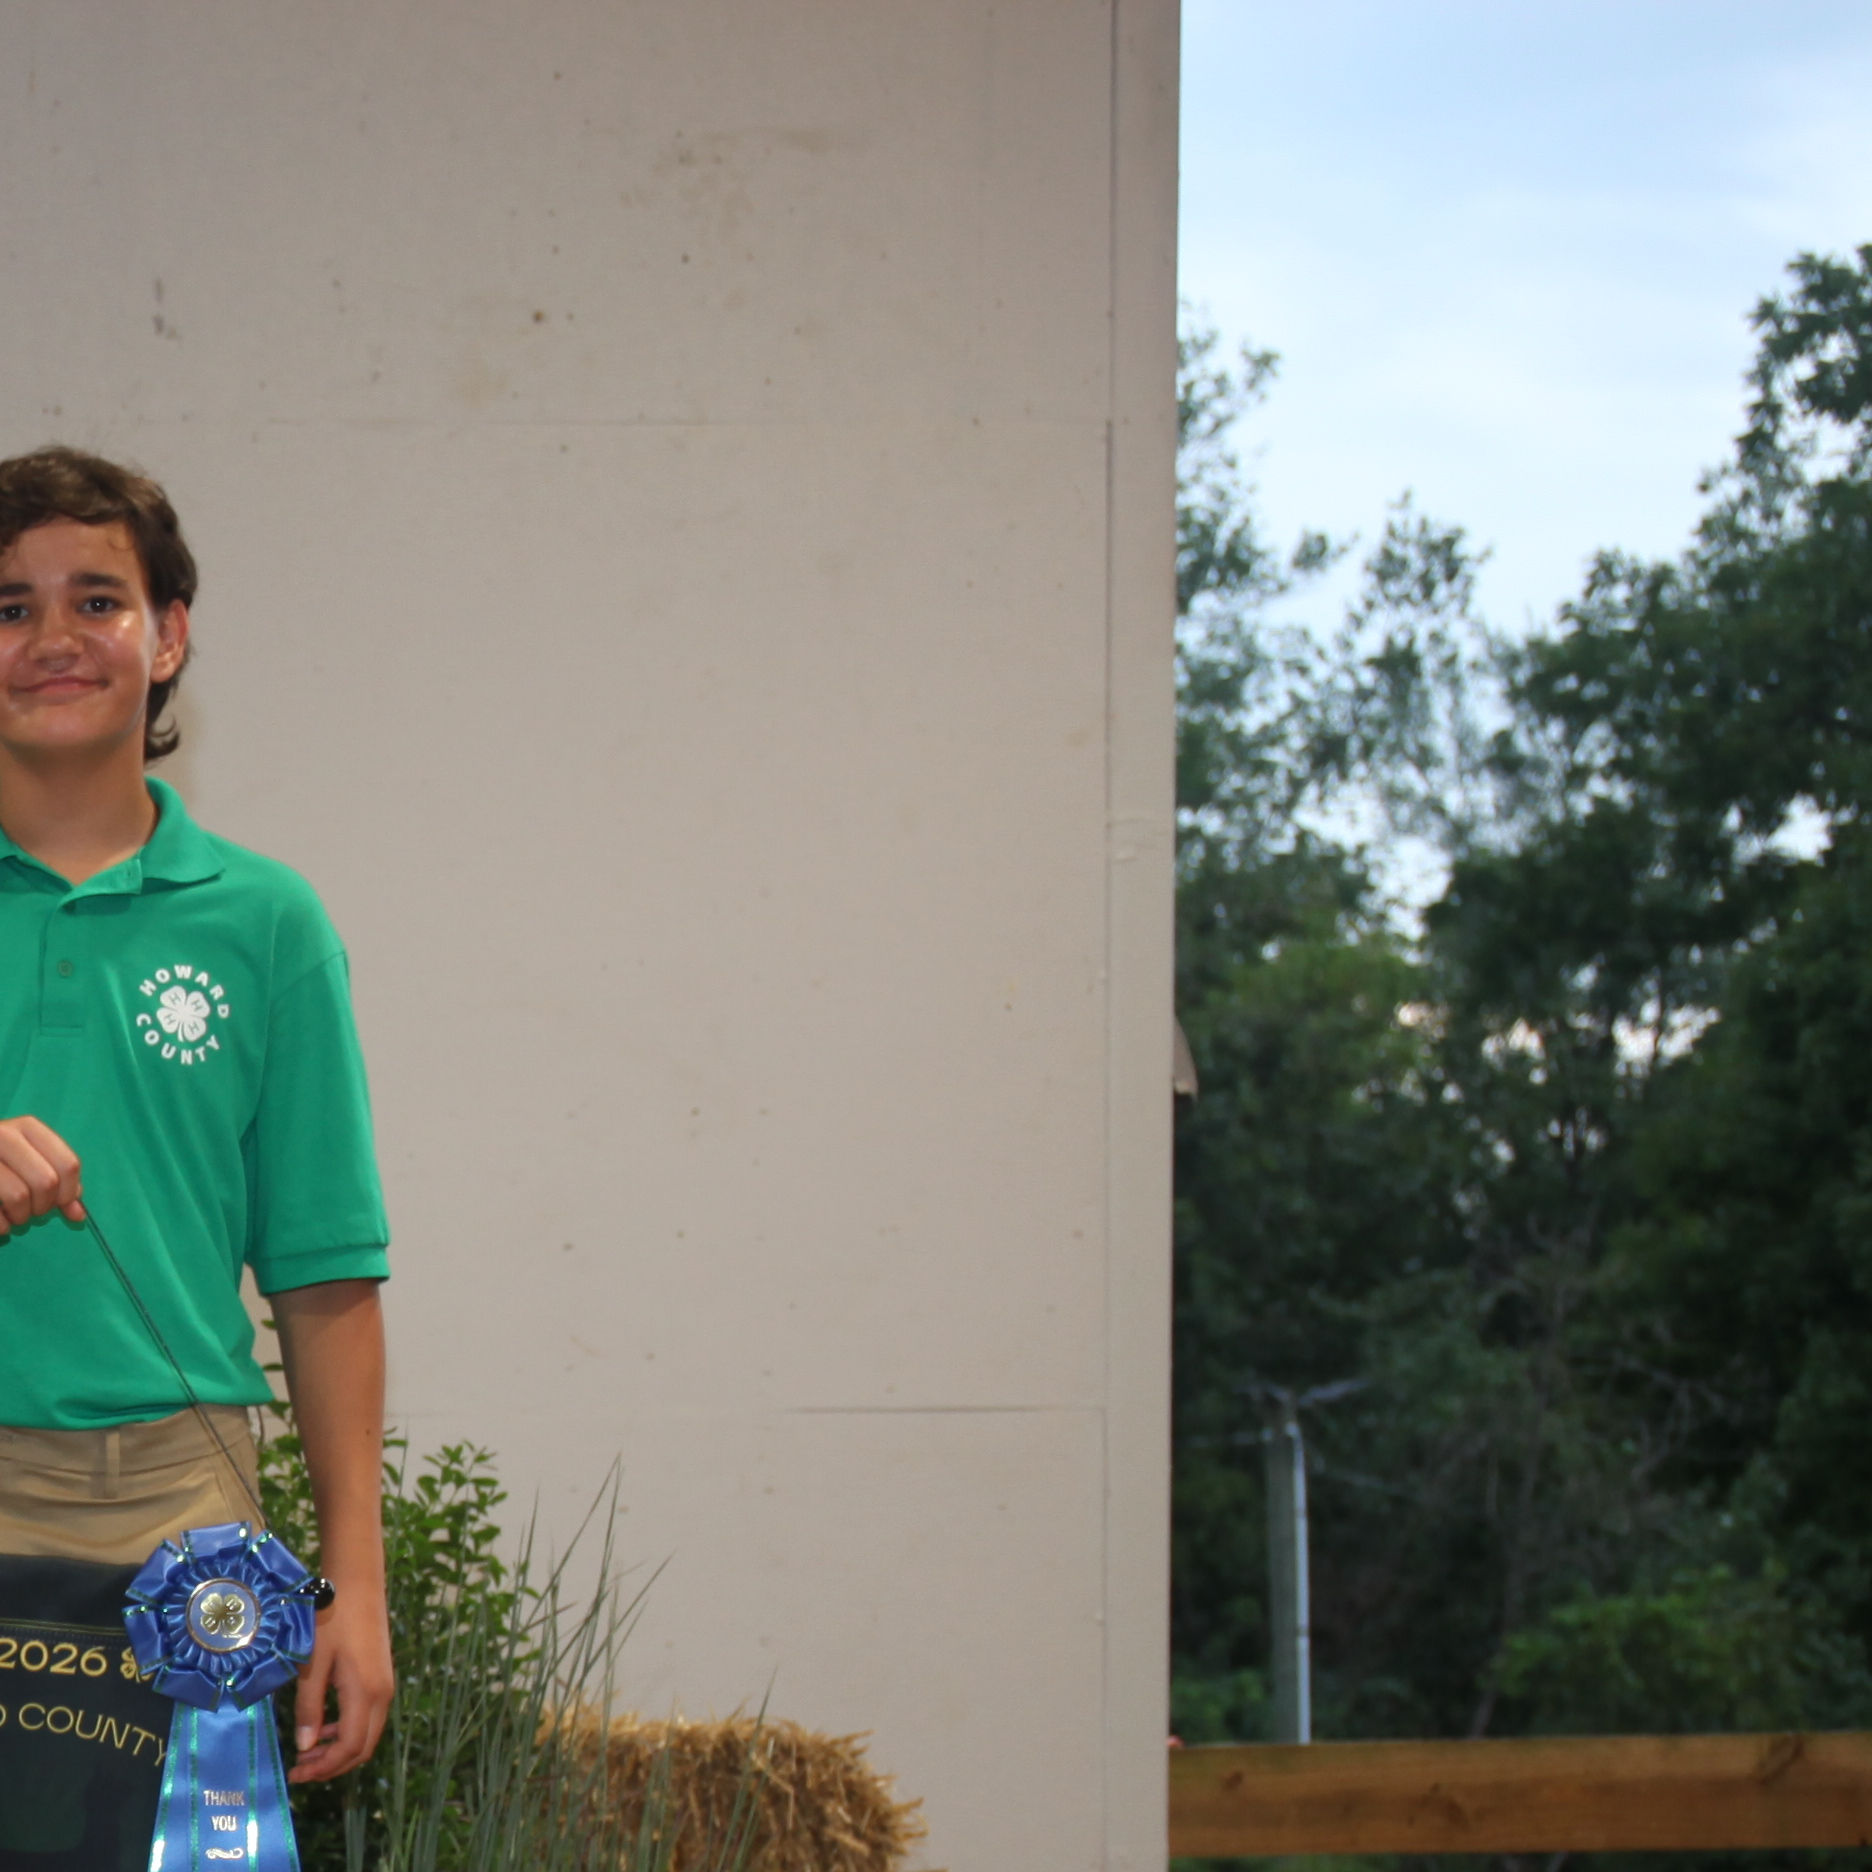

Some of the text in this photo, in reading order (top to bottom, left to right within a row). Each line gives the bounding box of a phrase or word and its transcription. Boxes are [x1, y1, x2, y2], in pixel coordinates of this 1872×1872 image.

[137, 963, 230, 1019] HOWARD
[136, 1013, 220, 1065] COUNTY
[18, 1702, 167, 1767] COUNTY
[203, 1790, 245, 1806] THANK
[211, 1815, 237, 1831] YOU
